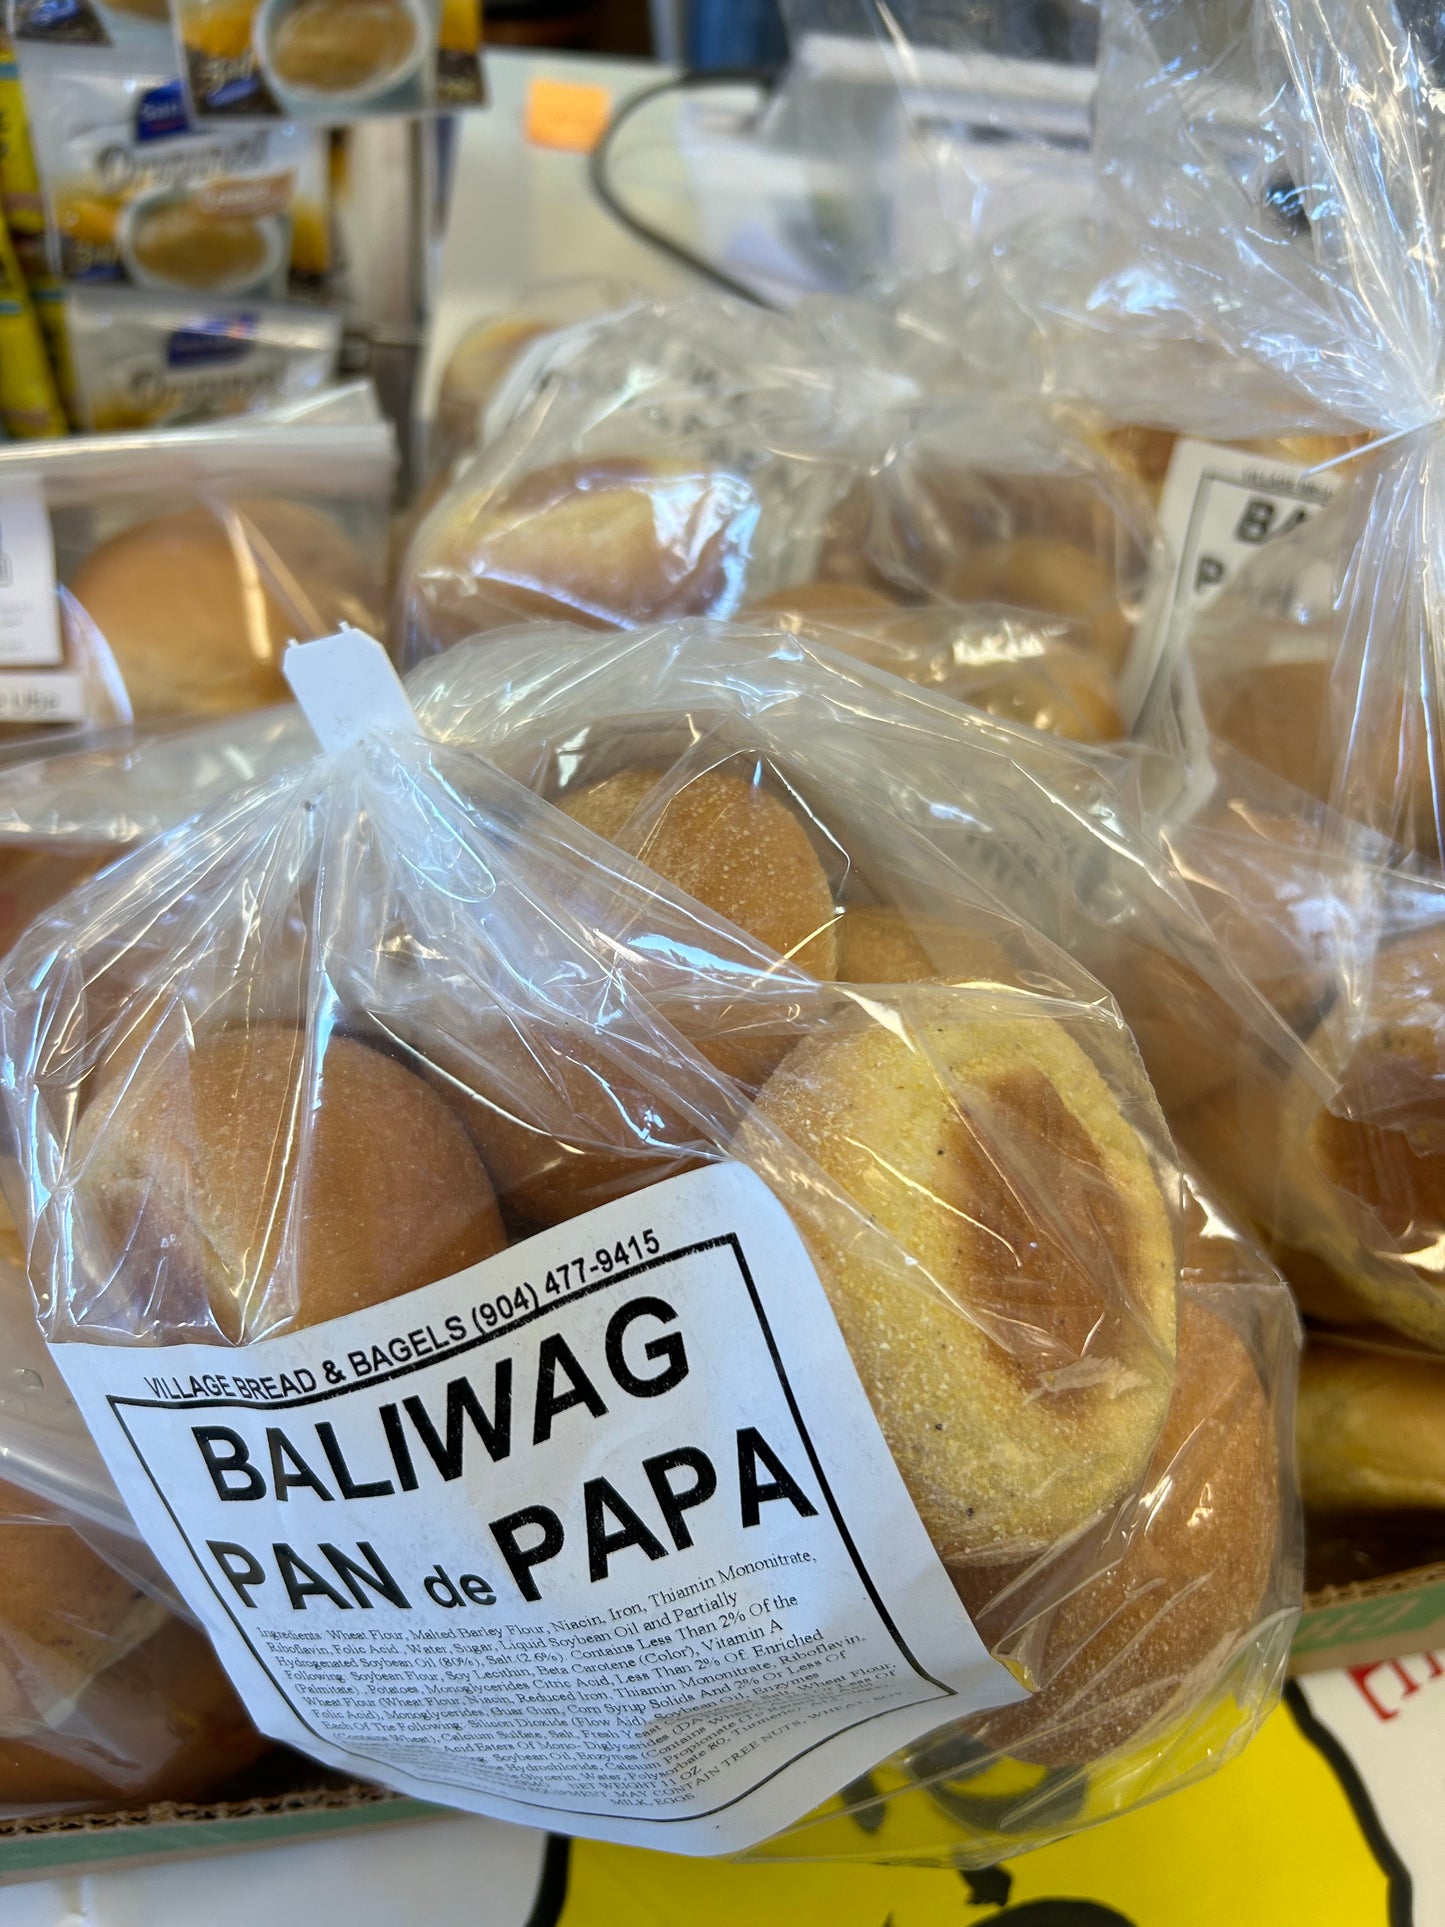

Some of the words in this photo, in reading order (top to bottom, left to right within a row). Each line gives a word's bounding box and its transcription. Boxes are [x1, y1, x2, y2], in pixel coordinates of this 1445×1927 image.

[144, 1373, 237, 1400] VILLAGE
[236, 1368, 318, 1400] BREAD
[322, 1359, 347, 1384] &
[352, 1315, 468, 1378] BAGELS
[472, 1281, 542, 1337] (904)
[543, 1228, 662, 1297] 477-9415
[191, 1295, 690, 1502] BALIWAG
[205, 1539, 413, 1611] PAN
[423, 1565, 498, 1609] de
[488, 1425, 820, 1602] PAPA
[266, 1641, 334, 1656] Riboflavin,
[333, 1644, 367, 1655] Folic
[407, 1643, 454, 1655] Water,
[453, 1642, 500, 1655] Sugar,
[500, 1637, 548, 1652] Liquid
[549, 1630, 612, 1649] Soybean
[613, 1621, 640, 1638] Oil
[643, 1612, 672, 1631] and
[672, 1591, 738, 1623] Partially
[326, 1630, 367, 1641] Wheat
[370, 1630, 410, 1642] Flour,
[408, 1628, 457, 1640] Malted
[457, 1626, 503, 1639] Barley
[505, 1623, 550, 1636] Flour,
[550, 1615, 607, 1632] Niacin,
[608, 1602, 648, 1621] Iron,
[648, 1577, 717, 1608] Thiamin
[716, 1551, 817, 1585] Mononitrate,
[275, 1656, 359, 1670] Hydrogenated
[359, 1656, 414, 1670] Soybean
[414, 1657, 438, 1668] Oil
[438, 1656, 485, 1669] (80%),
[570, 1642, 636, 1661] Contains
[636, 1634, 673, 1651] Less
[675, 1620, 718, 1642] Than
[718, 1608, 747, 1629] 2%
[749, 1598, 774, 1617] Of
[773, 1593, 799, 1611] the
[350, 1670, 403, 1684] Soybean
[405, 1670, 444, 1682] Flour,
[446, 1670, 471, 1683] Soy
[474, 1664, 536, 1680] Lecithin,
[536, 1663, 569, 1677] Beta
[571, 1657, 637, 1674] Carotene
[638, 1644, 700, 1667] (Color),
[701, 1623, 766, 1653] Vitamin
[769, 1617, 784, 1635] A
[368, 1684, 426, 1696] Potatoes,
[425, 1678, 530, 1695] Monoglycerides
[532, 1677, 572, 1690] Citric
[575, 1674, 614, 1688] Acid,
[615, 1670, 650, 1685] Less
[651, 1662, 694, 1679] Than
[694, 1656, 721, 1671] 2%
[751, 1628, 824, 1658] Enriched
[302, 1696, 342, 1708] Wheat
[344, 1696, 377, 1708] Flour
[378, 1696, 424, 1708] (Wheat
[469, 1694, 515, 1707] Niacin,
[516, 1689, 579, 1704] Reduced
[578, 1688, 614, 1701] Iron,
[613, 1682, 677, 1699] Thiamin
[678, 1661, 778, 1690] Mononitrate,
[778, 1634, 867, 1666] Riboflavin,
[312, 1709, 346, 1719] Folic
[346, 1709, 384, 1721] Acid),
[383, 1708, 491, 1721] Monoglycerides,
[490, 1705, 524, 1716] Guar
[526, 1705, 566, 1717] Gum,
[567, 1703, 603, 1714] Corn
[604, 1700, 647, 1718] Syrup
[649, 1694, 697, 1710] Solids
[700, 1684, 732, 1699] And
[733, 1676, 760, 1690] 2%
[763, 1670, 783, 1682] Or
[787, 1659, 823, 1675] Less
[826, 1649, 848, 1663] Of
[320, 1720, 354, 1731] Each
[353, 1721, 371, 1731] Of
[372, 1721, 397, 1732] The
[468, 1718, 515, 1729] Silicon
[514, 1717, 569, 1729] Dioxide
[570, 1715, 611, 1729] (Flow
[653, 1699, 718, 1721] Soybean
[752, 1672, 821, 1696] Enzymes
[440, 1731, 495, 1743] Calcium
[495, 1730, 546, 1741] Sulfate,
[582, 1728, 620, 1739] Fresh
[621, 1723, 663, 1740] Yeast
[850, 1662, 897, 1678] Flour,
[492, 1752, 548, 1764] Soybean
[578, 1750, 638, 1764] Enzymes
[516, 1740, 535, 1751] Of
[583, 1732, 671, 1752] Diglycerides
[604, 1759, 661, 1773] Calcium
[651, 1766, 722, 1798] CONTAIN
[720, 1740, 761, 1768] TREE
[679, 1765, 703, 1782] OZ
